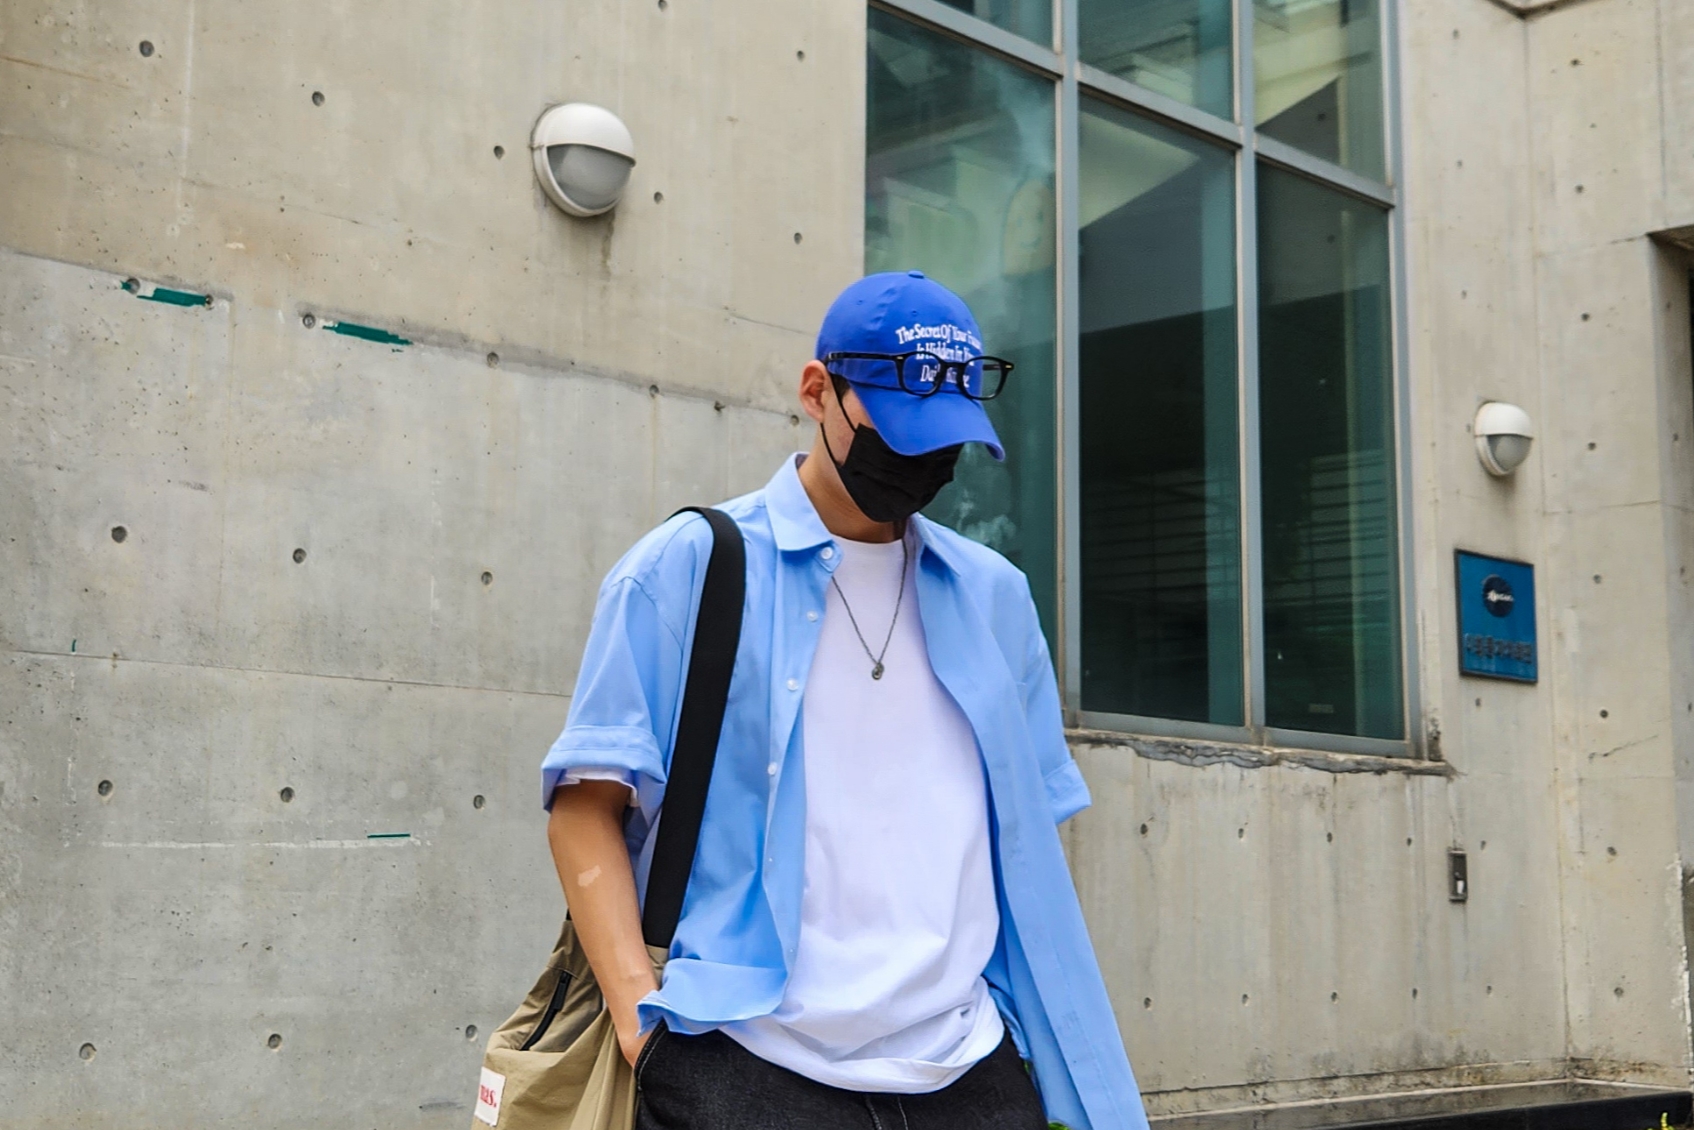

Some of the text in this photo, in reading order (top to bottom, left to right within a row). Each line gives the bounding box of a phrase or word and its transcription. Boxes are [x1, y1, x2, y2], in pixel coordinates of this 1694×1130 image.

[896, 325, 915, 344] The
[914, 323, 940, 339] Secret
[940, 324, 952, 343] Of
[916, 343, 925, 360] Is
[920, 363, 942, 382] Dai
